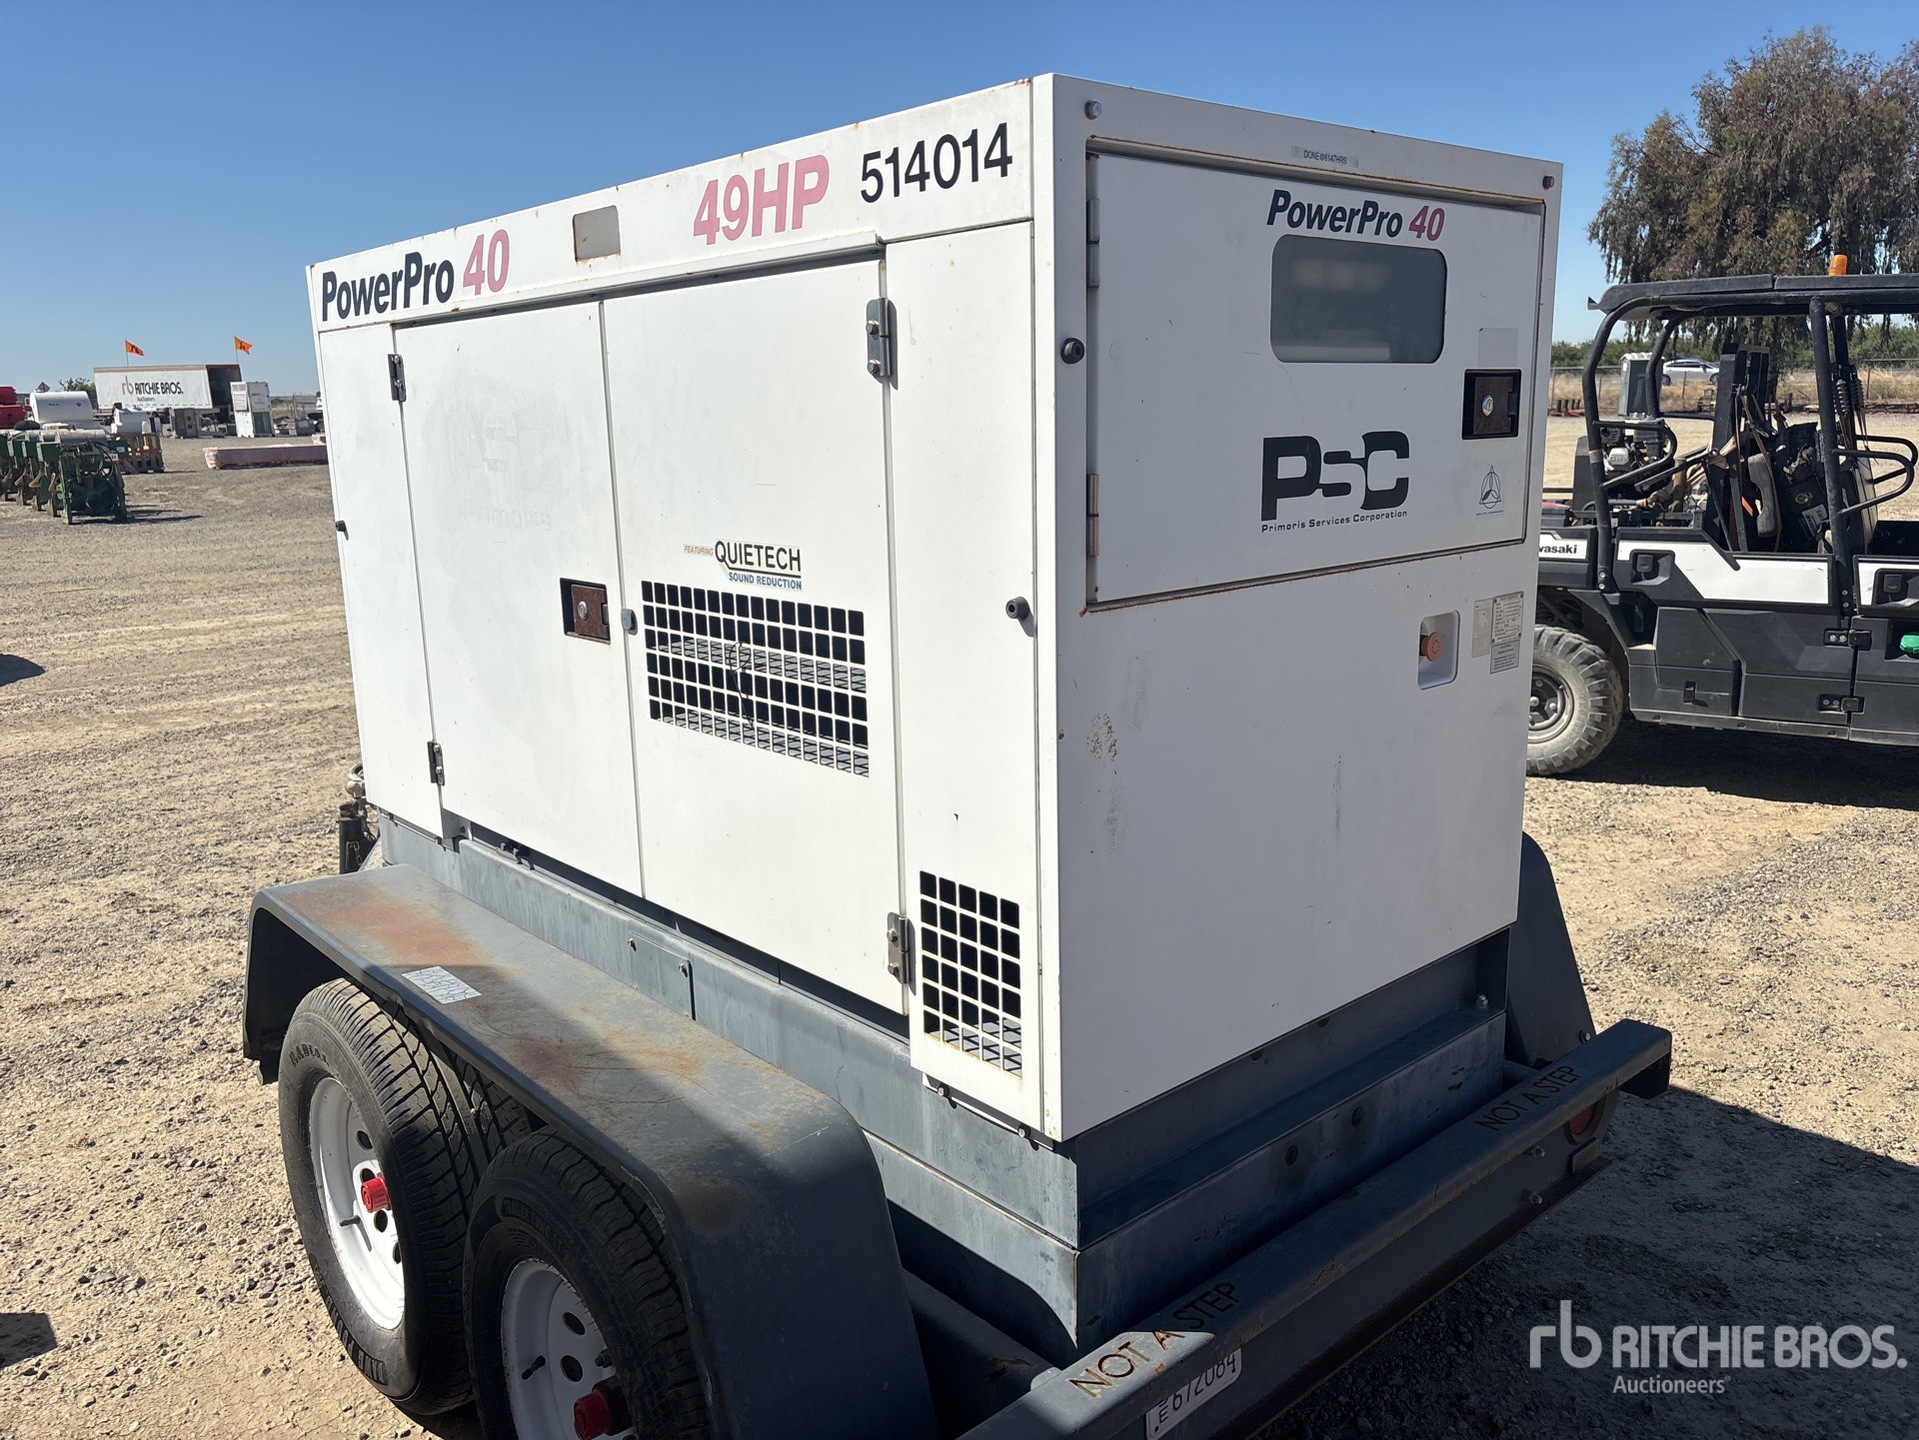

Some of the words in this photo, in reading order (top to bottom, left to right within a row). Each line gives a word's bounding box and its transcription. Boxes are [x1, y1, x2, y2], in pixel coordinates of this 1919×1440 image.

[860, 122, 1014, 204] 514014
[693, 154, 830, 246] 49HP
[1266, 188, 1403, 238] PowerPro
[1408, 205, 1445, 242] 40
[322, 250, 455, 322] PowerPro
[462, 229, 510, 296] 40
[135, 382, 160, 395] RITCHIE
[161, 381, 184, 395] BROS.
[1261, 430, 1410, 522] PSC
[1261, 518, 1306, 533] Primoris
[1308, 516, 1351, 528] Services
[1353, 510, 1408, 523] Corporation
[684, 544, 714, 556] FEATURING
[714, 540, 802, 572] QUIETECH
[728, 571, 755, 584] SOUND
[756, 575, 803, 591] REDUCTION
[1533, 1065, 1581, 1093] STEP
[1522, 1091, 1550, 1105] A
[1473, 1100, 1530, 1131] NOT
[1068, 1340, 1151, 1398] NOT
[1151, 1329, 1186, 1351] A
[1172, 1281, 1240, 1330] STEP
